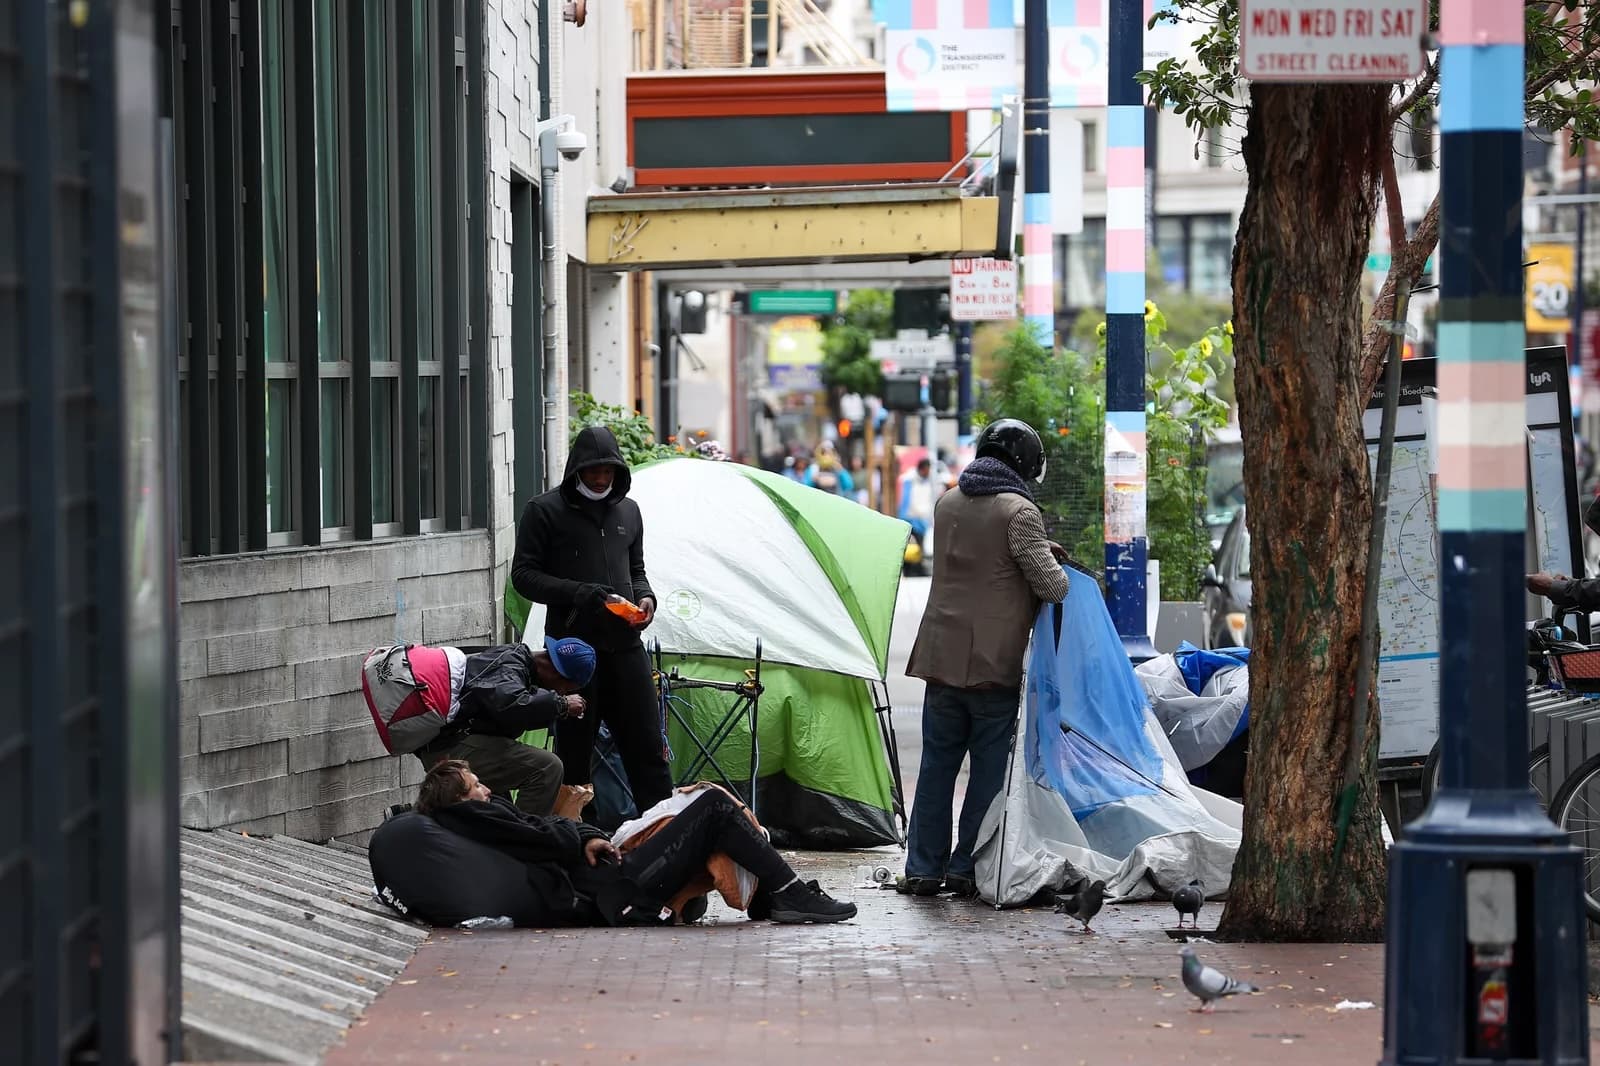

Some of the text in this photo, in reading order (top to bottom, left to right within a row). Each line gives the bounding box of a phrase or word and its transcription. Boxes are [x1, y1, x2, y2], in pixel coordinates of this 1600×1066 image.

[1252, 9, 1415, 36] MON WED FRI SAT
[1257, 53, 1408, 70] STREET CLEANING
[1532, 282, 1568, 310] 20
[1530, 371, 1552, 386] lyft
[382, 886, 408, 914] Big Joe
